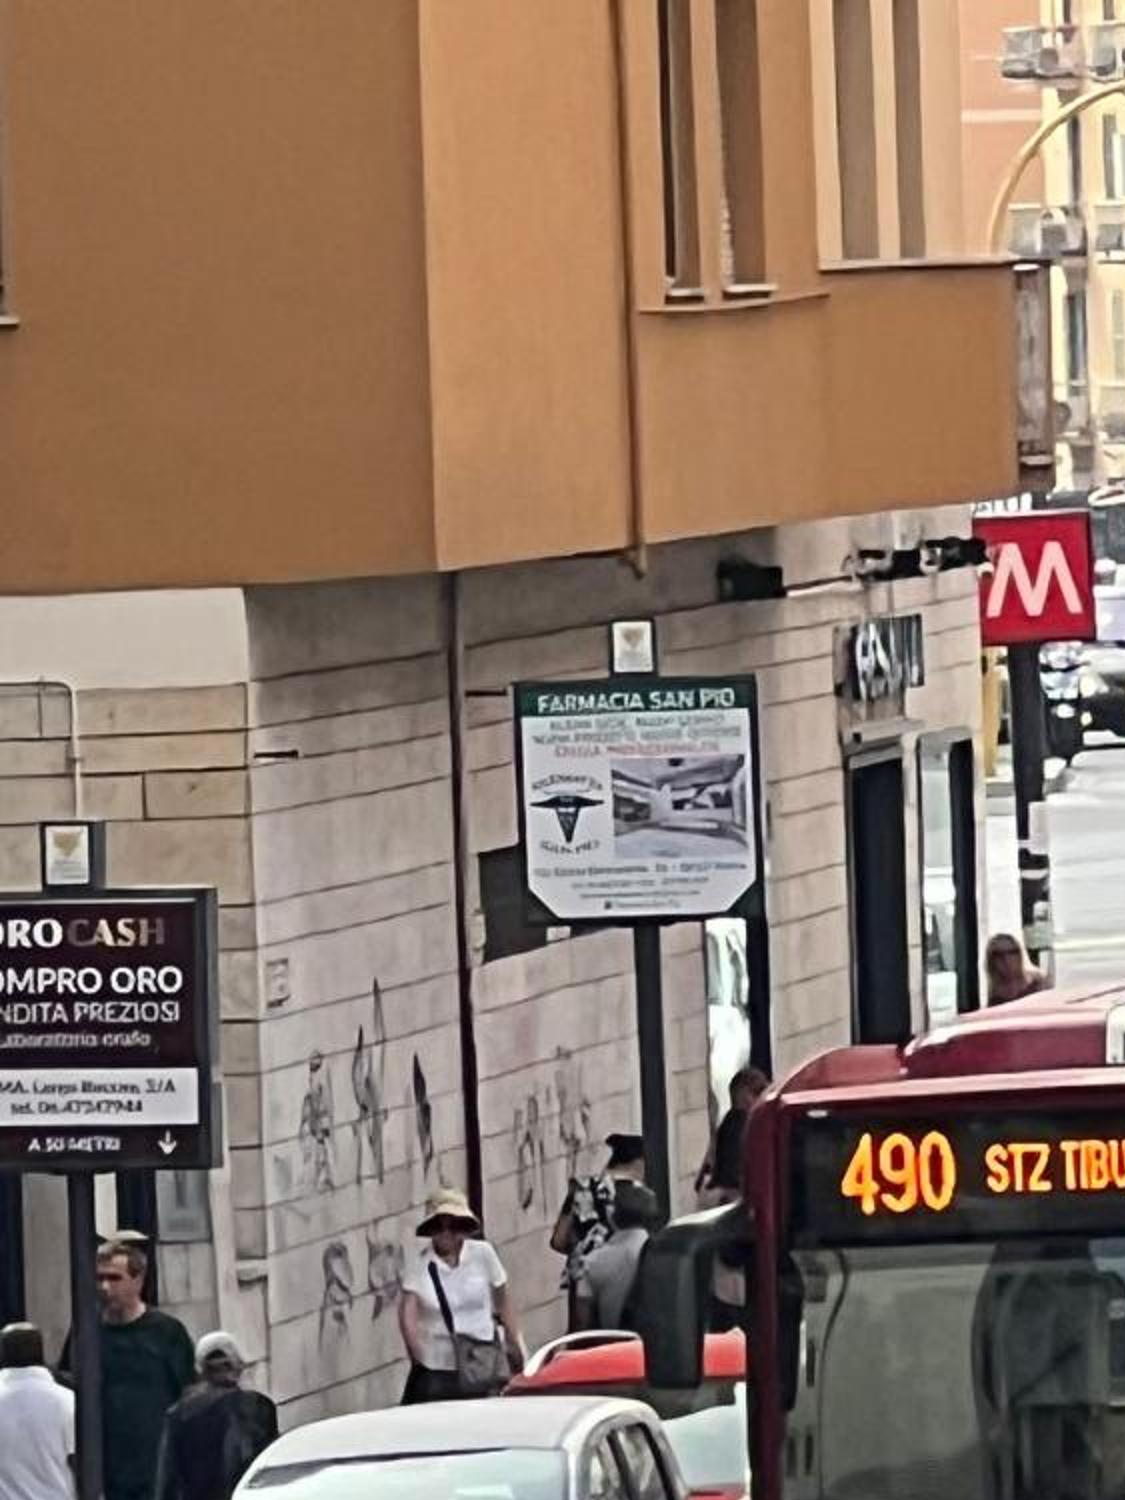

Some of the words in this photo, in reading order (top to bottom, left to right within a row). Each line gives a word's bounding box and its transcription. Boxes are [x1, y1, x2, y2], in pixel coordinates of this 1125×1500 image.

[986, 540, 1083, 618] M
[537, 693, 646, 713] FARMACIA
[649, 690, 694, 709] SAN
[699, 687, 735, 708] PIO
[0, 918, 63, 949] RO
[66, 917, 166, 947] CASH
[110, 965, 184, 994] ORO
[74, 1000, 181, 1023] PREZIOSI
[28, 1137, 41, 1152] A
[841, 1130, 957, 1217] 490
[983, 1143, 1053, 1193] STZ
